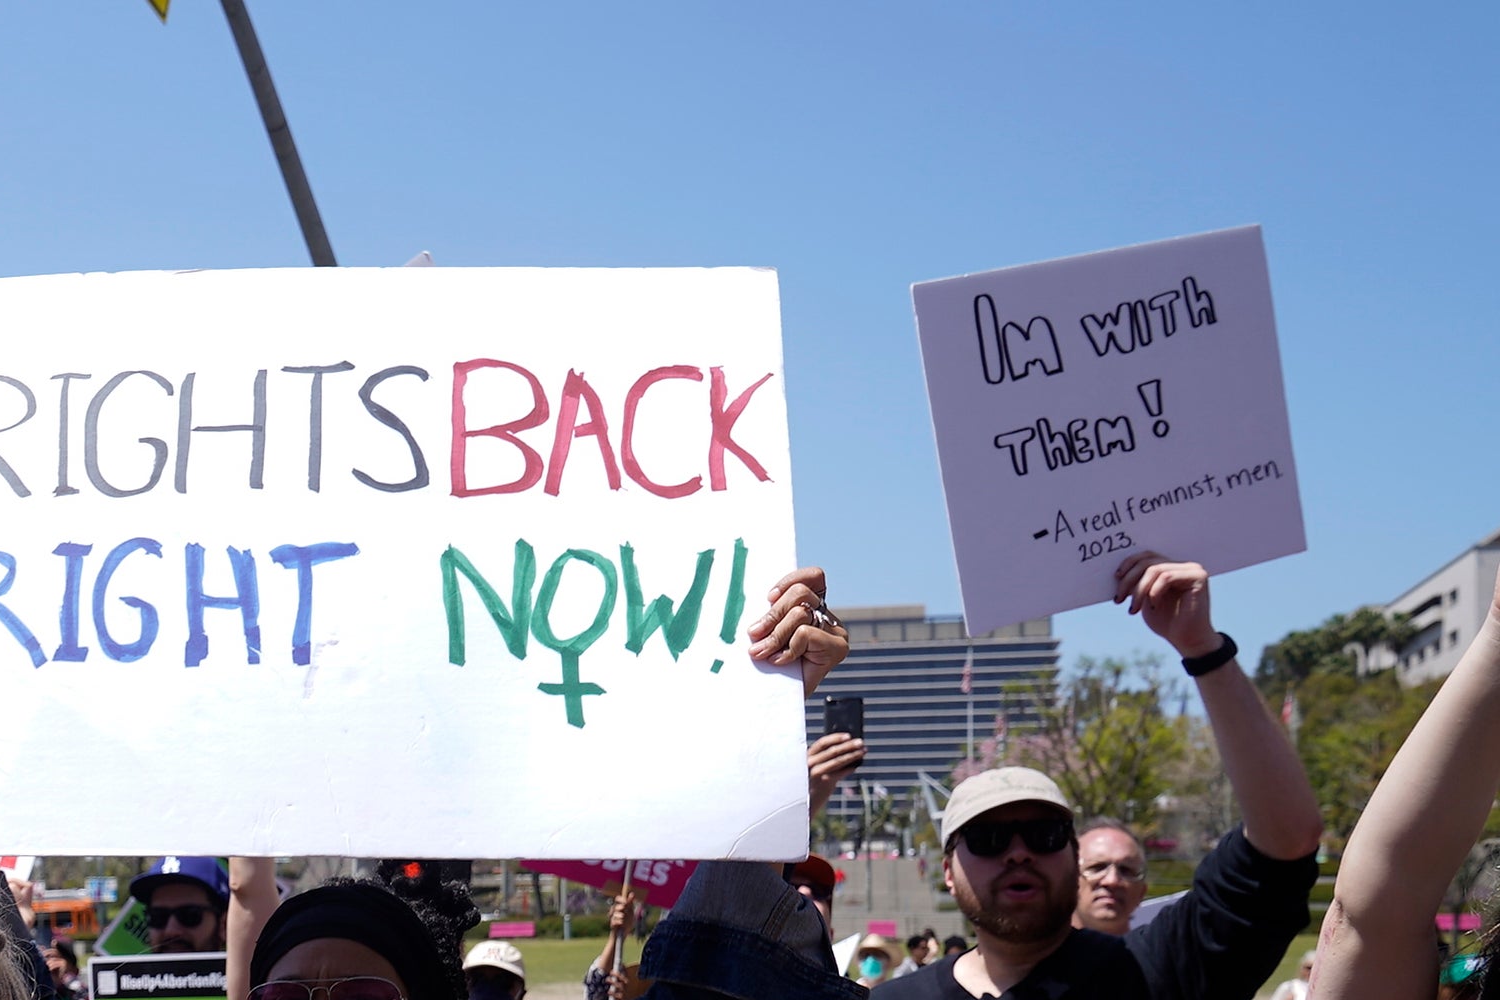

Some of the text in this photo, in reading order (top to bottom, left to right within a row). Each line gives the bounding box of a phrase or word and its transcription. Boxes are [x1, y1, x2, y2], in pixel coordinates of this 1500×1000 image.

[973, 293, 1064, 385] IM
[448, 358, 775, 500] BACK
[1080, 501, 1121, 534] real
[1126, 474, 1223, 523] feminist,
[439, 538, 749, 730] NOW!
[120, 971, 228, 992] RiseUp4AbortionRig
